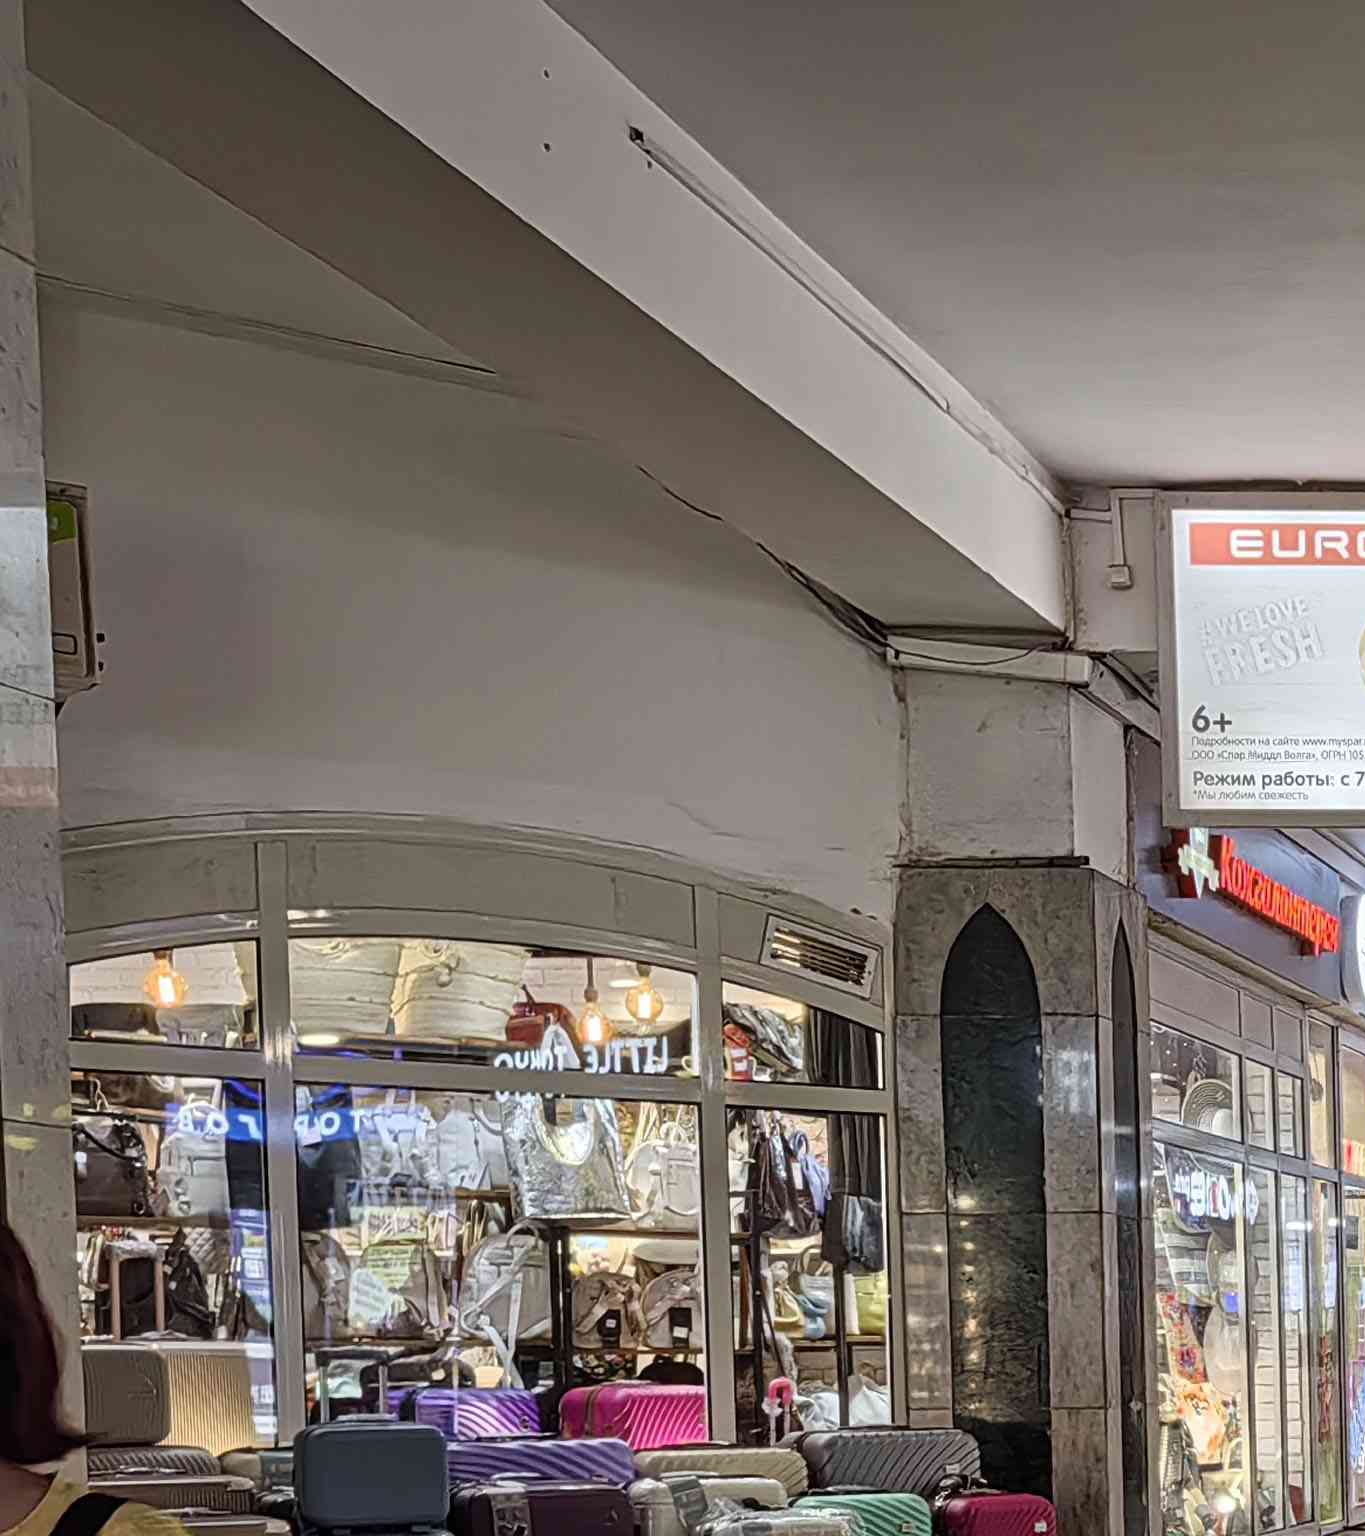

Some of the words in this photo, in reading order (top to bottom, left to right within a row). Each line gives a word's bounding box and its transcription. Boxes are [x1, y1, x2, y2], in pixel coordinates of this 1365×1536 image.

[1191, 705, 1232, 732] 6+
[1192, 736, 1256, 747] Подробности
[1258, 738, 1270, 746] на
[1272, 736, 1299, 746] сайте
[1192, 750, 1214, 760] ООО
[1320, 750, 1346, 760] ОГРН
[1193, 771, 1256, 786] Режим
[1262, 771, 1334, 790] работы:
[1340, 774, 1350, 786] с
[1220, 790, 1256, 800] любим
[1259, 790, 1309, 801] свежесть
